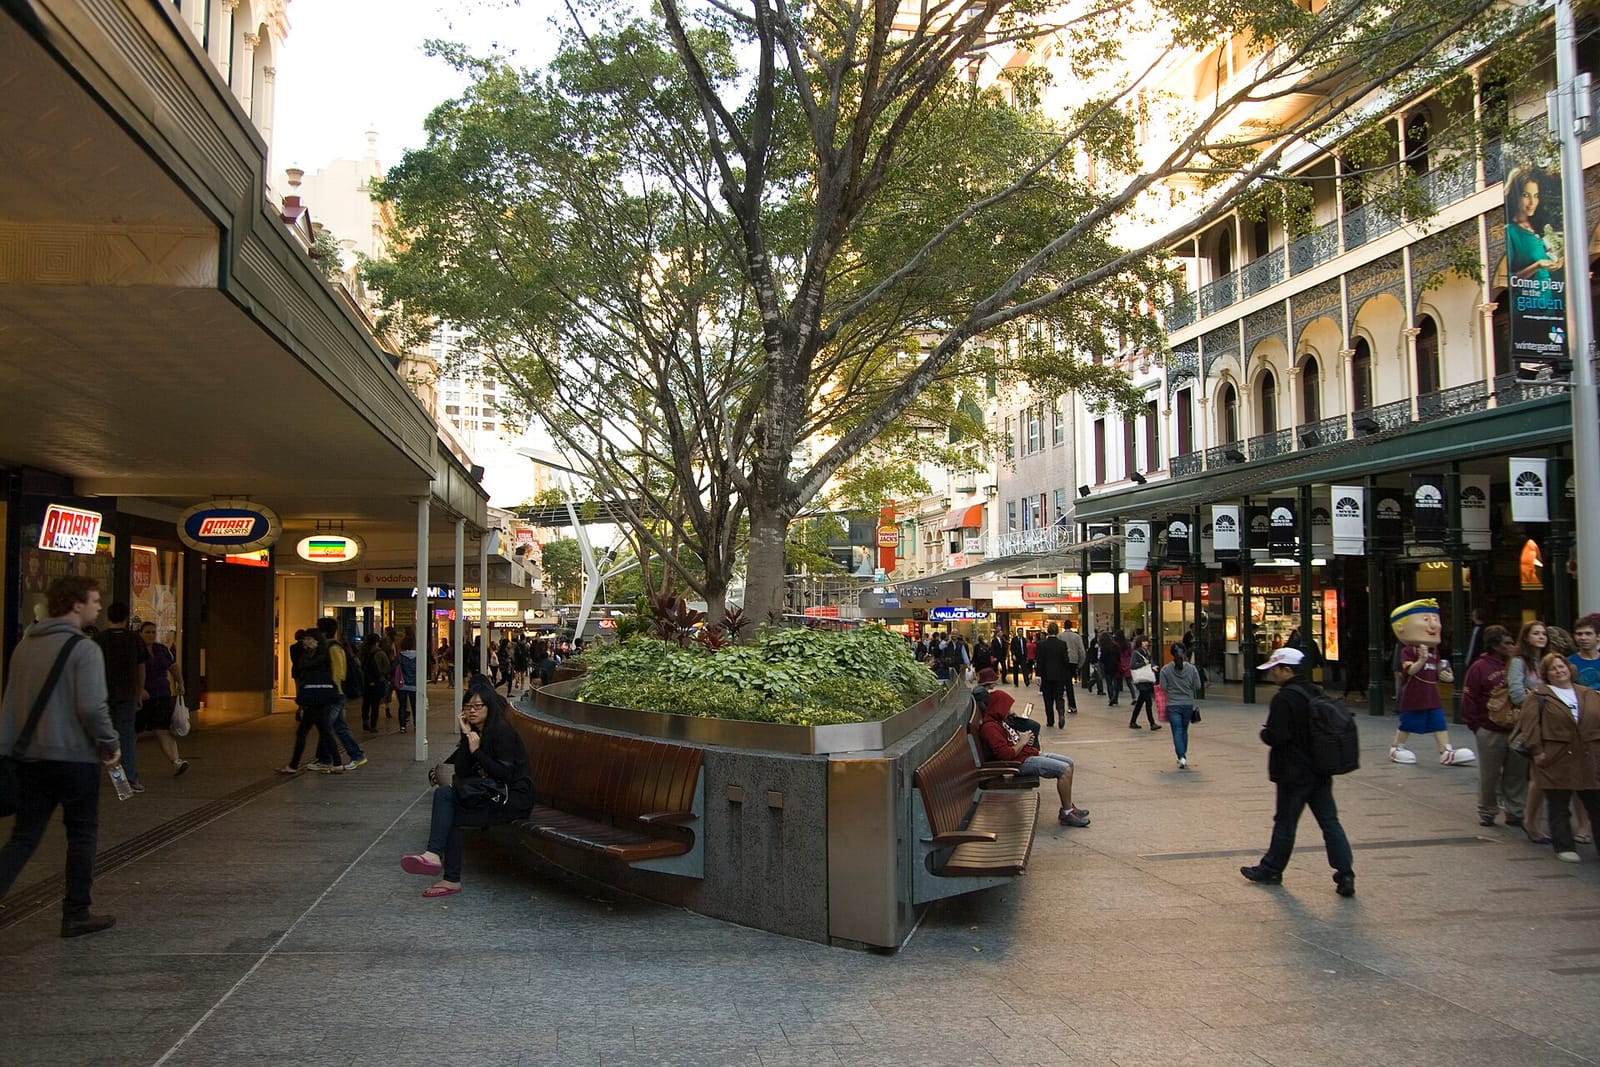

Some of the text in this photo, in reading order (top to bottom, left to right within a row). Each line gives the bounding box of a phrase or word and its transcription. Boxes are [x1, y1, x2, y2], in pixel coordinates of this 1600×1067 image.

[1510, 276, 1564, 293] Come play
[1529, 289, 1541, 297] the
[1517, 295, 1563, 311] garden
[1515, 341, 1561, 353] wintergarden
[42, 510, 99, 548] AMART
[202, 520, 253, 534] AMART
[486, 606, 517, 614] harmacy
